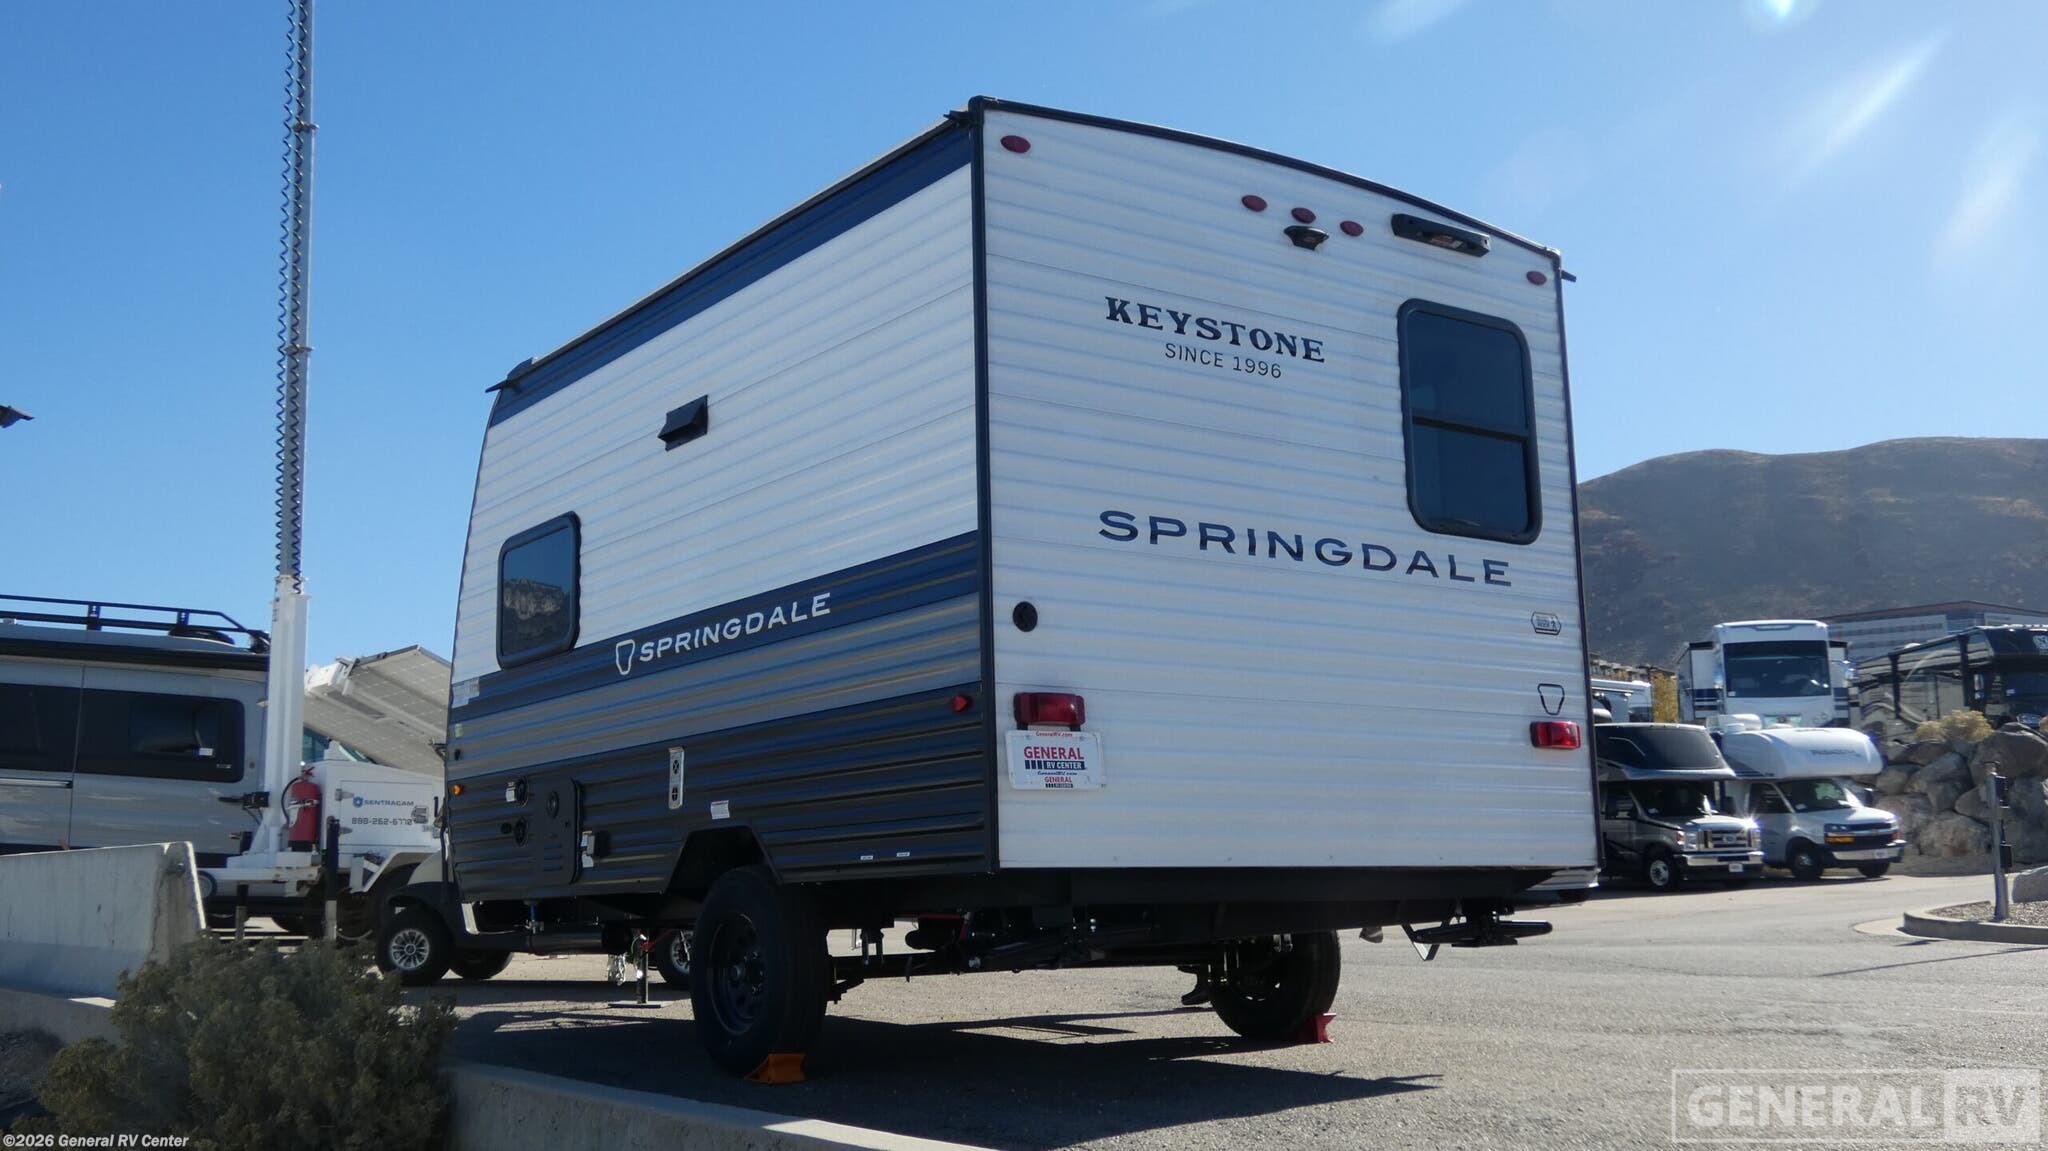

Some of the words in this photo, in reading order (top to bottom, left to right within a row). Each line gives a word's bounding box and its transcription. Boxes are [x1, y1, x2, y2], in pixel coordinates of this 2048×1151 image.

[1104, 296, 1325, 363] KEYSTONE
[1165, 342, 1224, 368] SINCE
[1232, 356, 1282, 379] 1996
[1098, 510, 1512, 587] SPRINGDALE
[639, 592, 831, 662] SPRINGDALE
[1023, 746, 1085, 760] GENERAL
[1046, 761, 1056, 769] RV
[1056, 761, 1082, 770] CENTER
[364, 799, 414, 807] SENTRACAM
